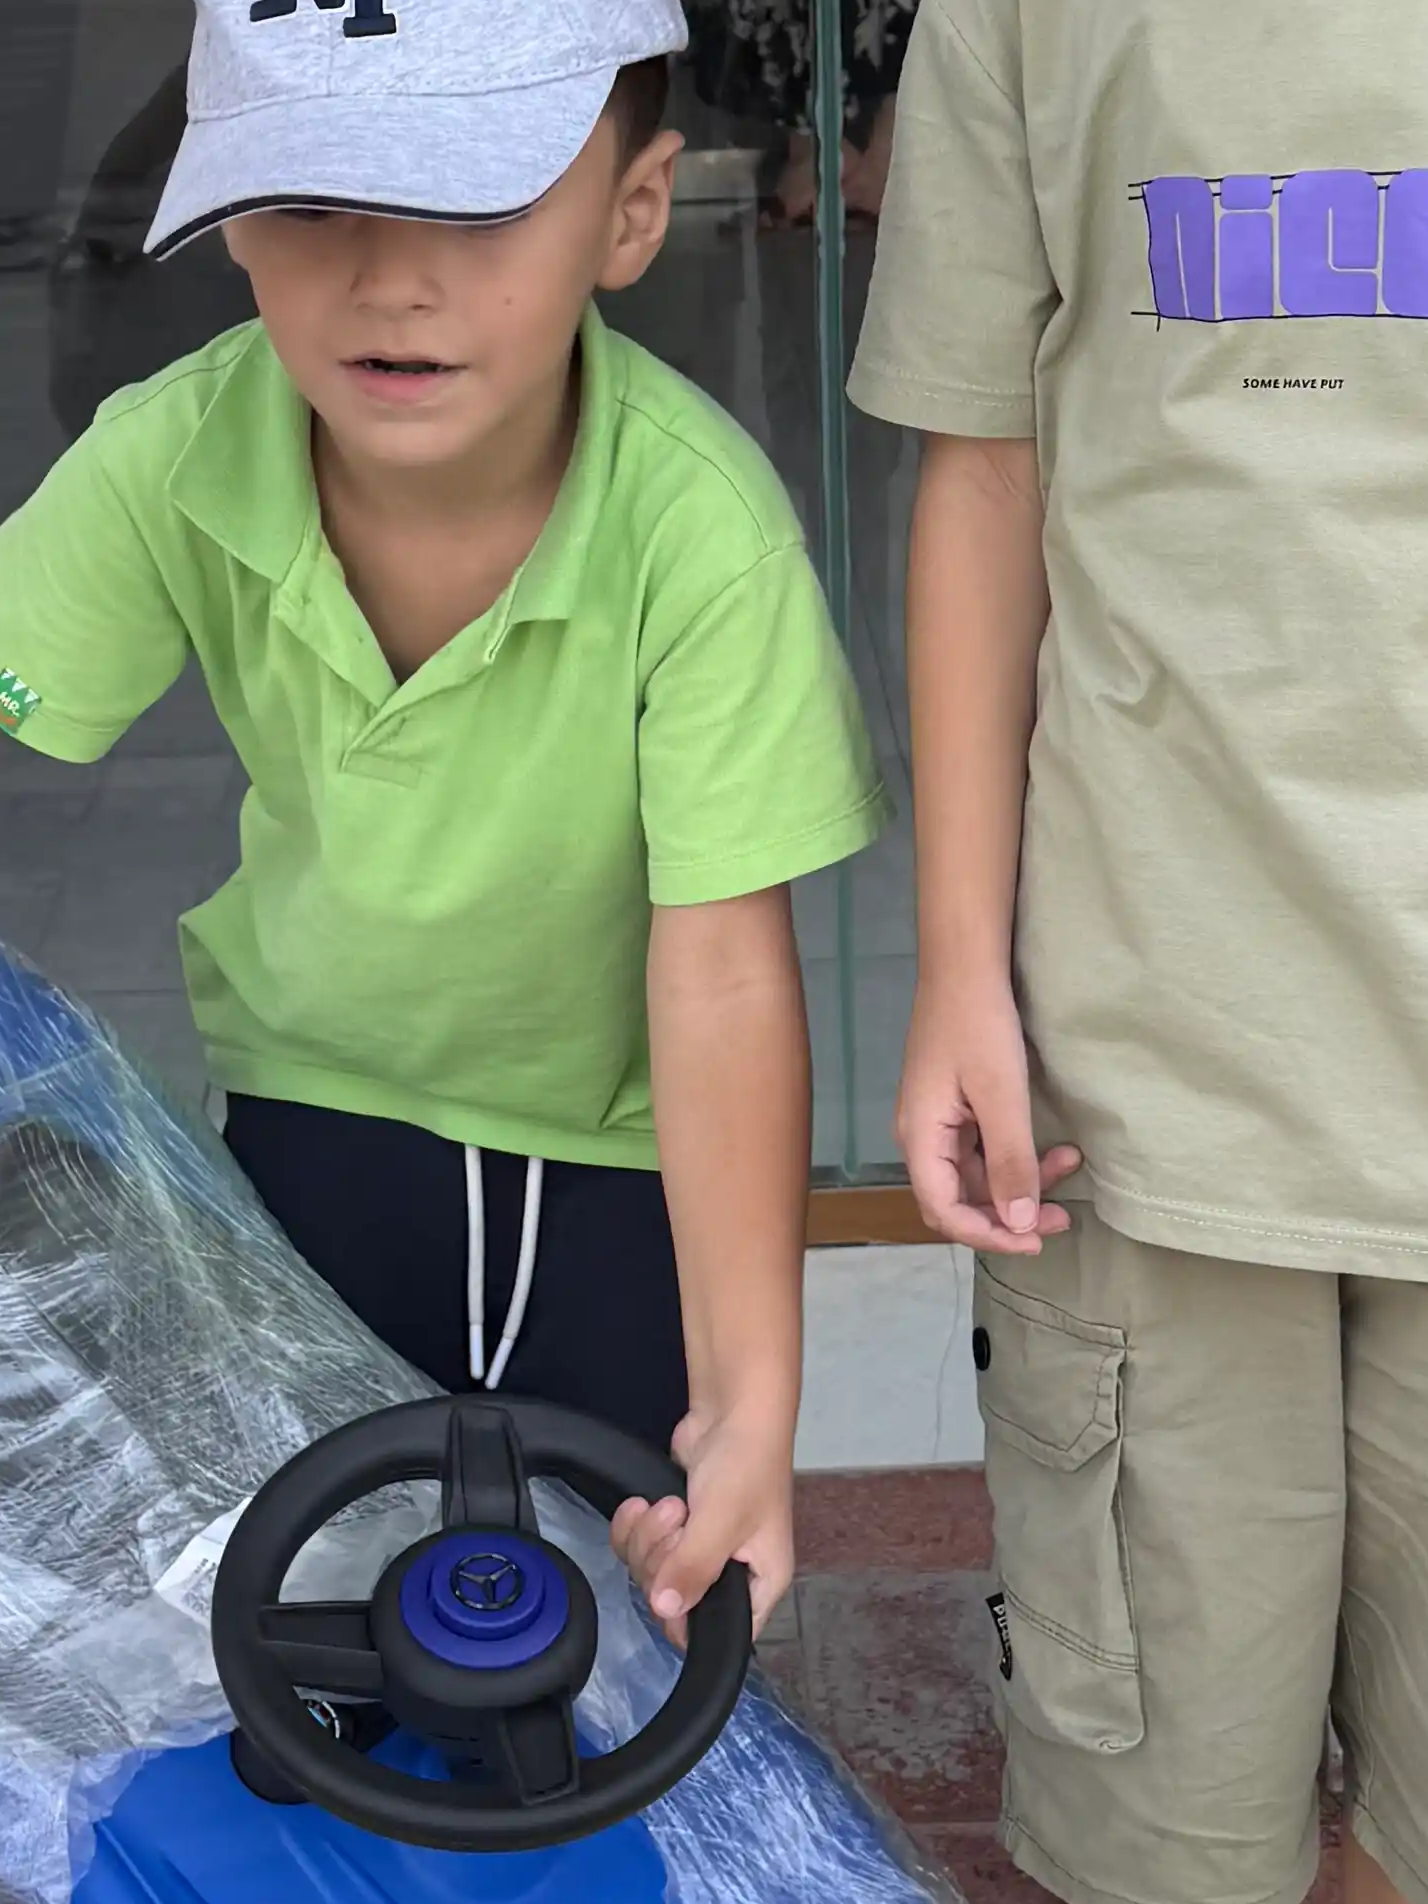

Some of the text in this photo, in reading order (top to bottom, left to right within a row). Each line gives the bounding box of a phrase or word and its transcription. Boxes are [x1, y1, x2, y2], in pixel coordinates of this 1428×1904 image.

[1242, 378, 1344, 389] SOME HAVE PUT
